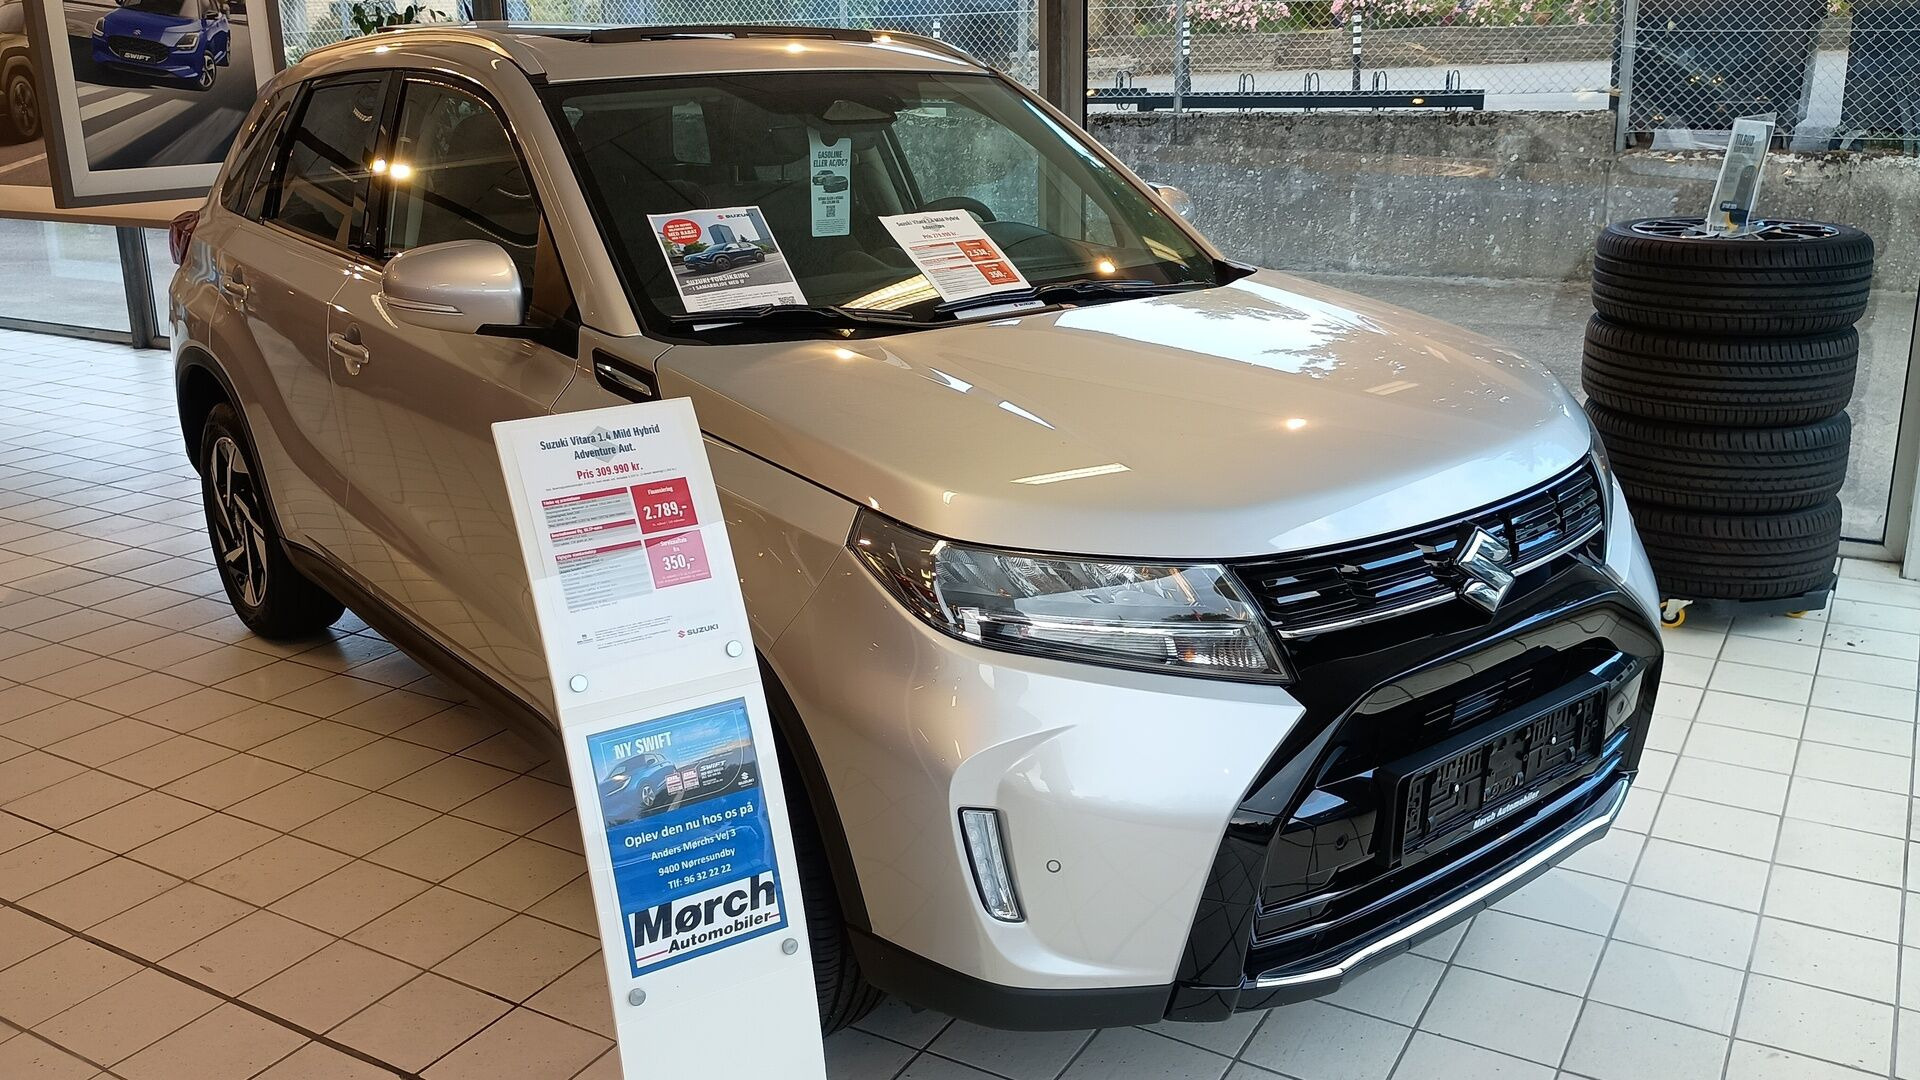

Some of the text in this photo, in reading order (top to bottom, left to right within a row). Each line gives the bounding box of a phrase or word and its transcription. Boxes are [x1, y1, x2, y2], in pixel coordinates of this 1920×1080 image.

[124, 53, 151, 62] SWIFT
[813, 158, 848, 168] ELLER AC/DC?
[817, 150, 843, 159] GASOLINE
[540, 424, 661, 451] Suzuki Vitara 1.4 Mild Hybrid
[574, 442, 637, 460] Adventure Aut.
[576, 469, 594, 480] Pris
[597, 463, 629, 477] 309.990
[631, 461, 643, 471] kr.
[643, 501, 688, 520] 2.789,-
[662, 553, 696, 571] 350,-
[686, 623, 719, 636] SUZUKI
[614, 741, 634, 760] NY
[636, 731, 673, 754] SWIFT
[700, 760, 727, 772] SWIFT
[1496, 790, 1540, 817] Automobiler
[624, 801, 754, 848] Oplev den nu hos os på
[651, 828, 737, 861] Anders Mørchs Vej 3
[658, 847, 736, 877] 9400 Nørresundby
[668, 863, 732, 890] Tlf: 96 32 22 22
[634, 875, 775, 948] Mørch
[667, 910, 772, 954] Automobiler
